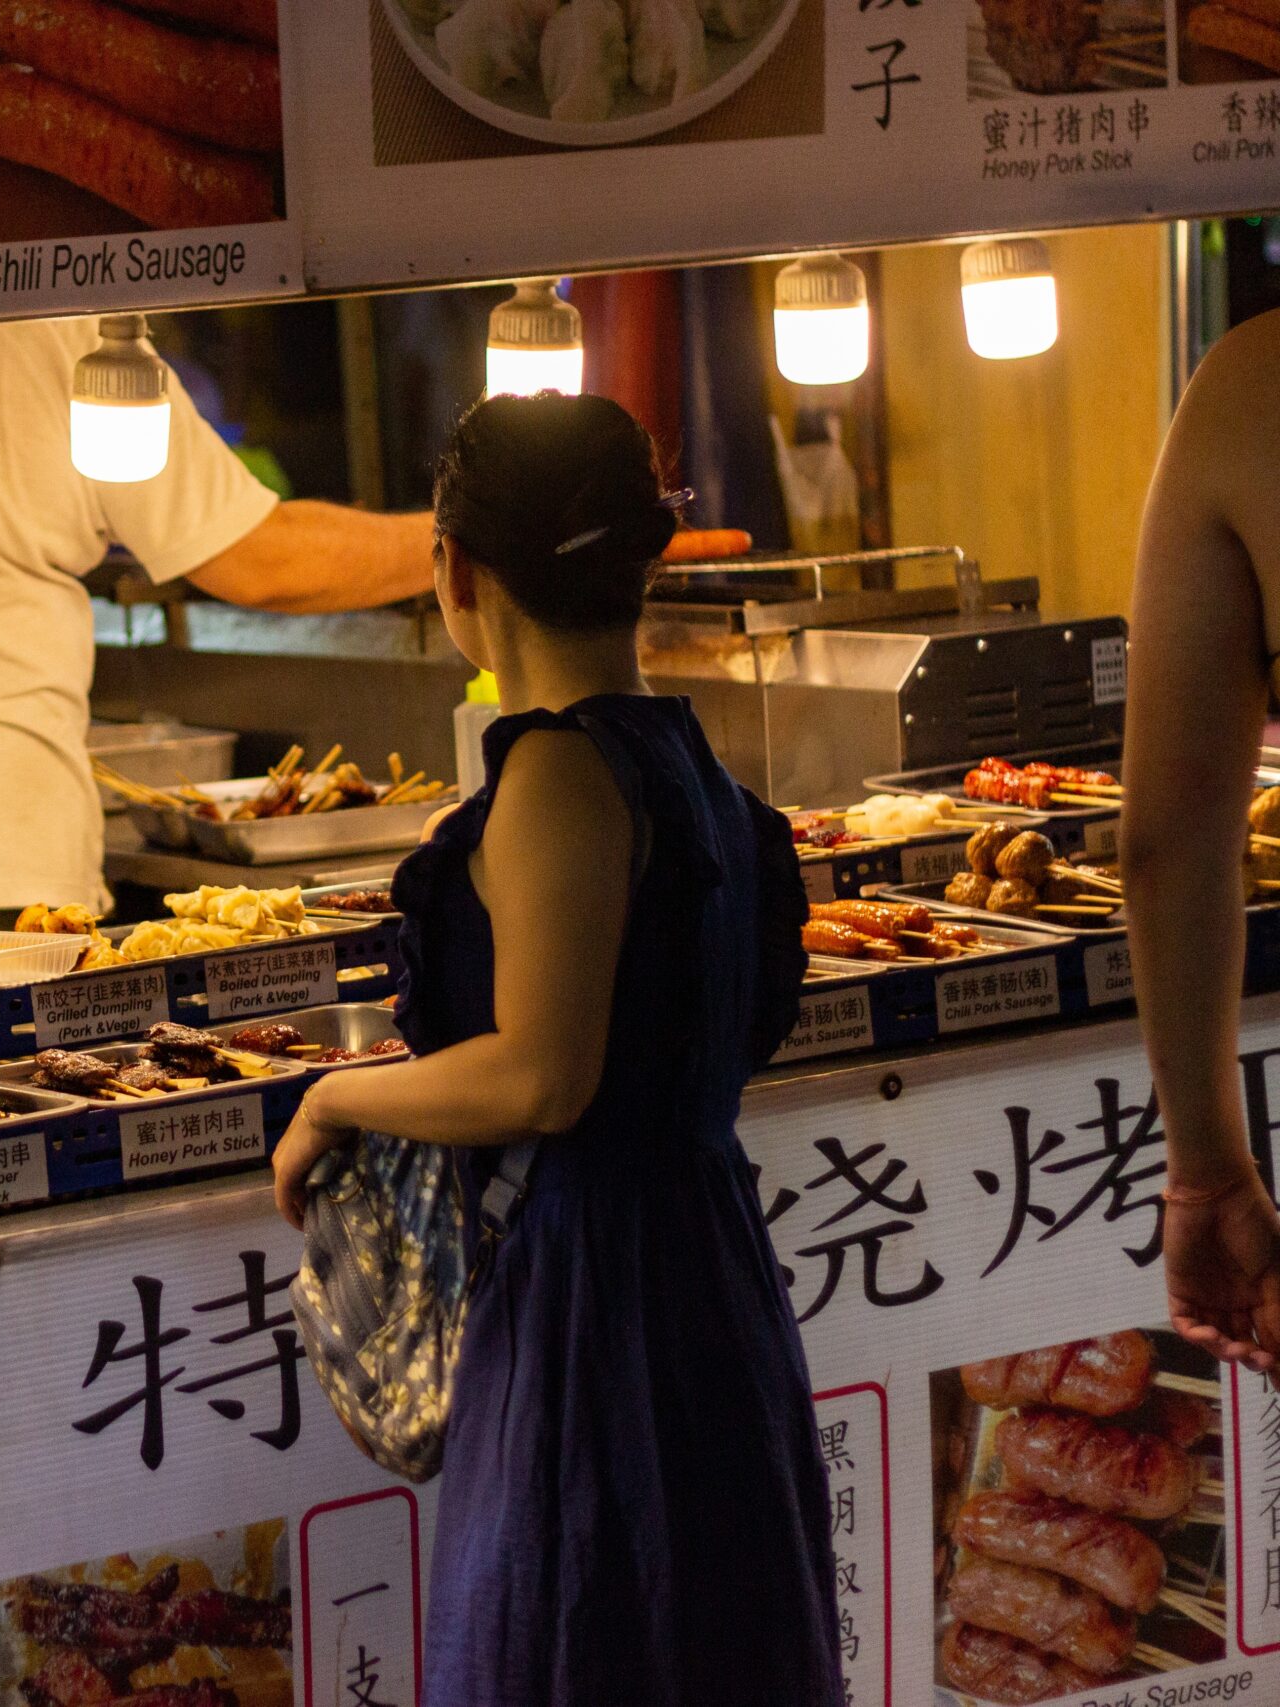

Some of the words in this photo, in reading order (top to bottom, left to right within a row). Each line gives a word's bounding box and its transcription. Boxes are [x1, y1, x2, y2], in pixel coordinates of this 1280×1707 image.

[850, 0, 921, 131] 子
[983, 98, 1150, 154] 蜜汁猪肉串
[982, 159, 1040, 181] Honey
[1045, 153, 1086, 177] Pork
[1091, 147, 1134, 172] Stick
[1192, 140, 1231, 163] Chili
[1237, 137, 1275, 160] Pork
[52, 241, 116, 288] Pork
[125, 238, 245, 286] Sausage
[219, 976, 259, 992] Boiled
[262, 969, 320, 986] Dumpling
[46, 1007, 89, 1024] Grilled
[91, 998, 152, 1017] Dumpling
[229, 995, 263, 1011] (Pork
[945, 1004, 970, 1019] Chili
[974, 1000, 1000, 1015] Pork
[1005, 993, 1054, 1010] Sausage
[58, 1025, 92, 1042] (Pork
[96, 1017, 140, 1034] &Vege)
[784, 1033, 813, 1048] Pork
[817, 1024, 867, 1042] Sausage
[136, 1106, 244, 1145] 蜜汁猪肉串
[129, 1149, 177, 1168] Honey
[182, 1140, 218, 1159] Pork
[223, 1133, 260, 1151] Stick
[71, 1249, 310, 1471] 特
